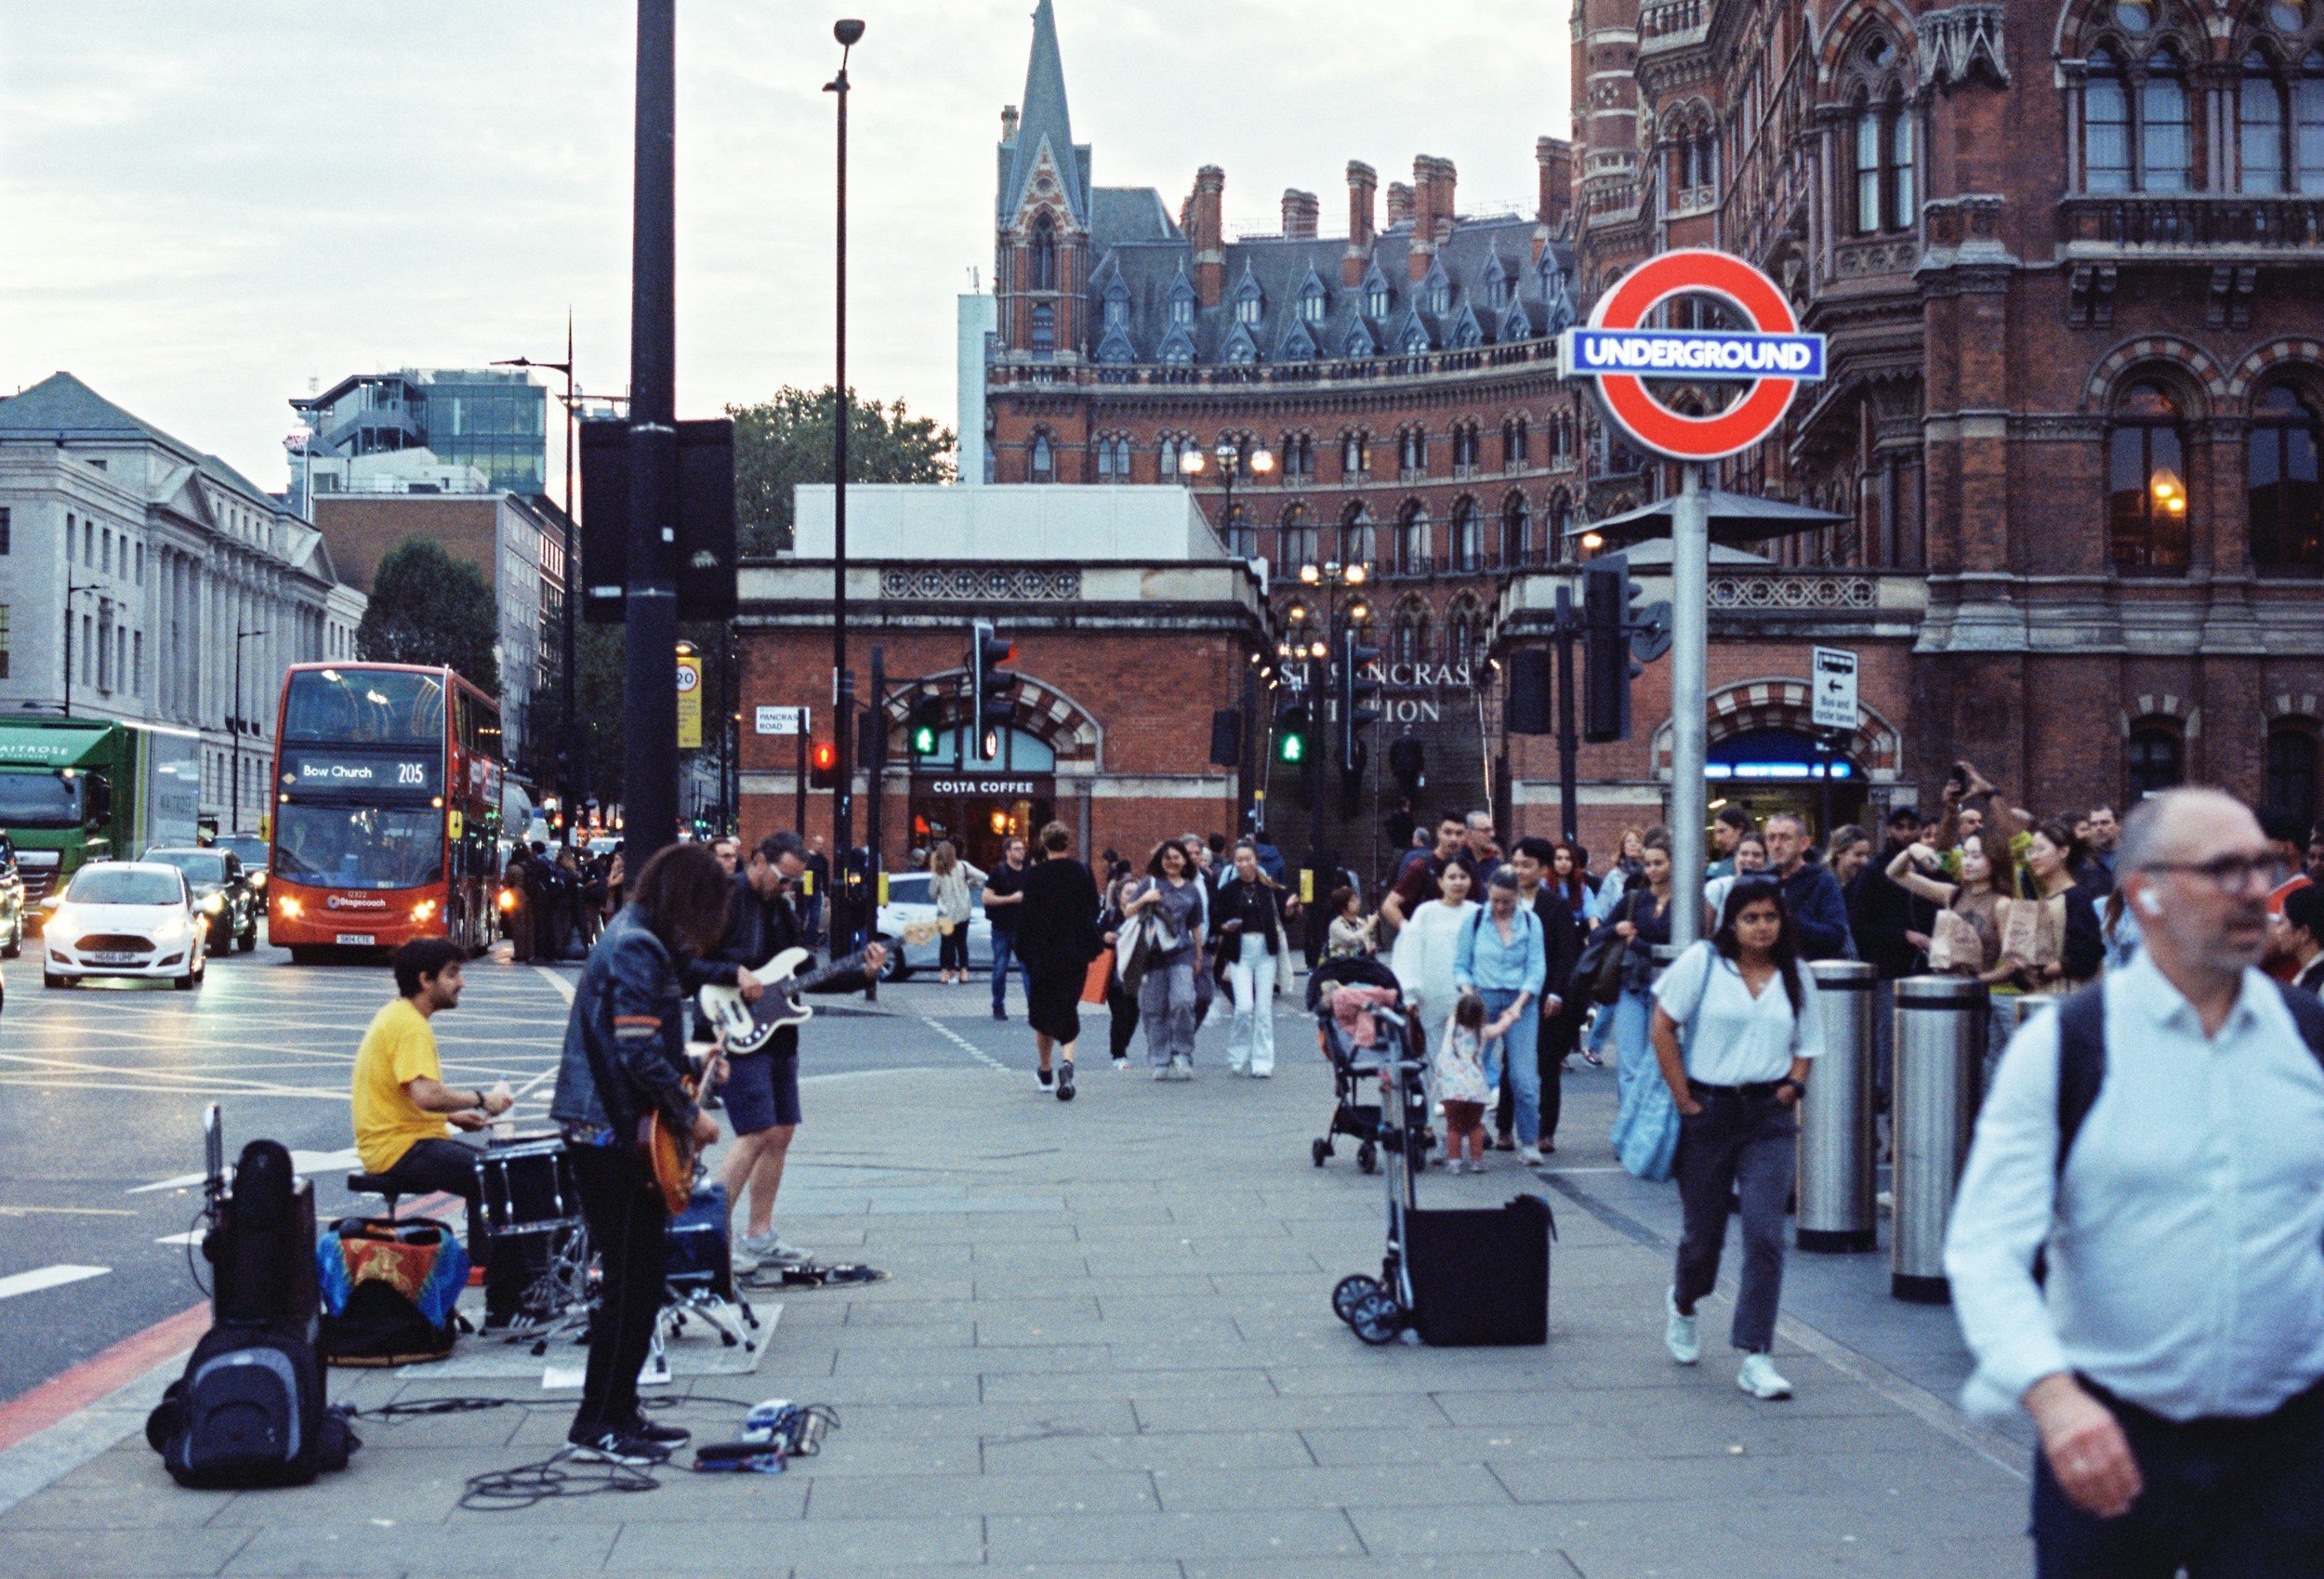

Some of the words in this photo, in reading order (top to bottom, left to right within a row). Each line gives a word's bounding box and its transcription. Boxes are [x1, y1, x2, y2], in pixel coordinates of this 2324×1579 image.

[1585, 337, 1811, 370] UNDERGROUND
[677, 672, 694, 685] 20
[1330, 662, 1469, 686] NCRAS
[1820, 694, 1835, 706] Bus
[1836, 699, 1850, 709] and
[0, 745, 70, 757] AITROSE
[303, 765, 328, 778] Bow
[331, 766, 373, 779] Church
[398, 763, 424, 783] 205
[932, 782, 976, 794] COSTA
[980, 782, 1034, 794] COFFEE
[339, 897, 386, 908] Stagecoach
